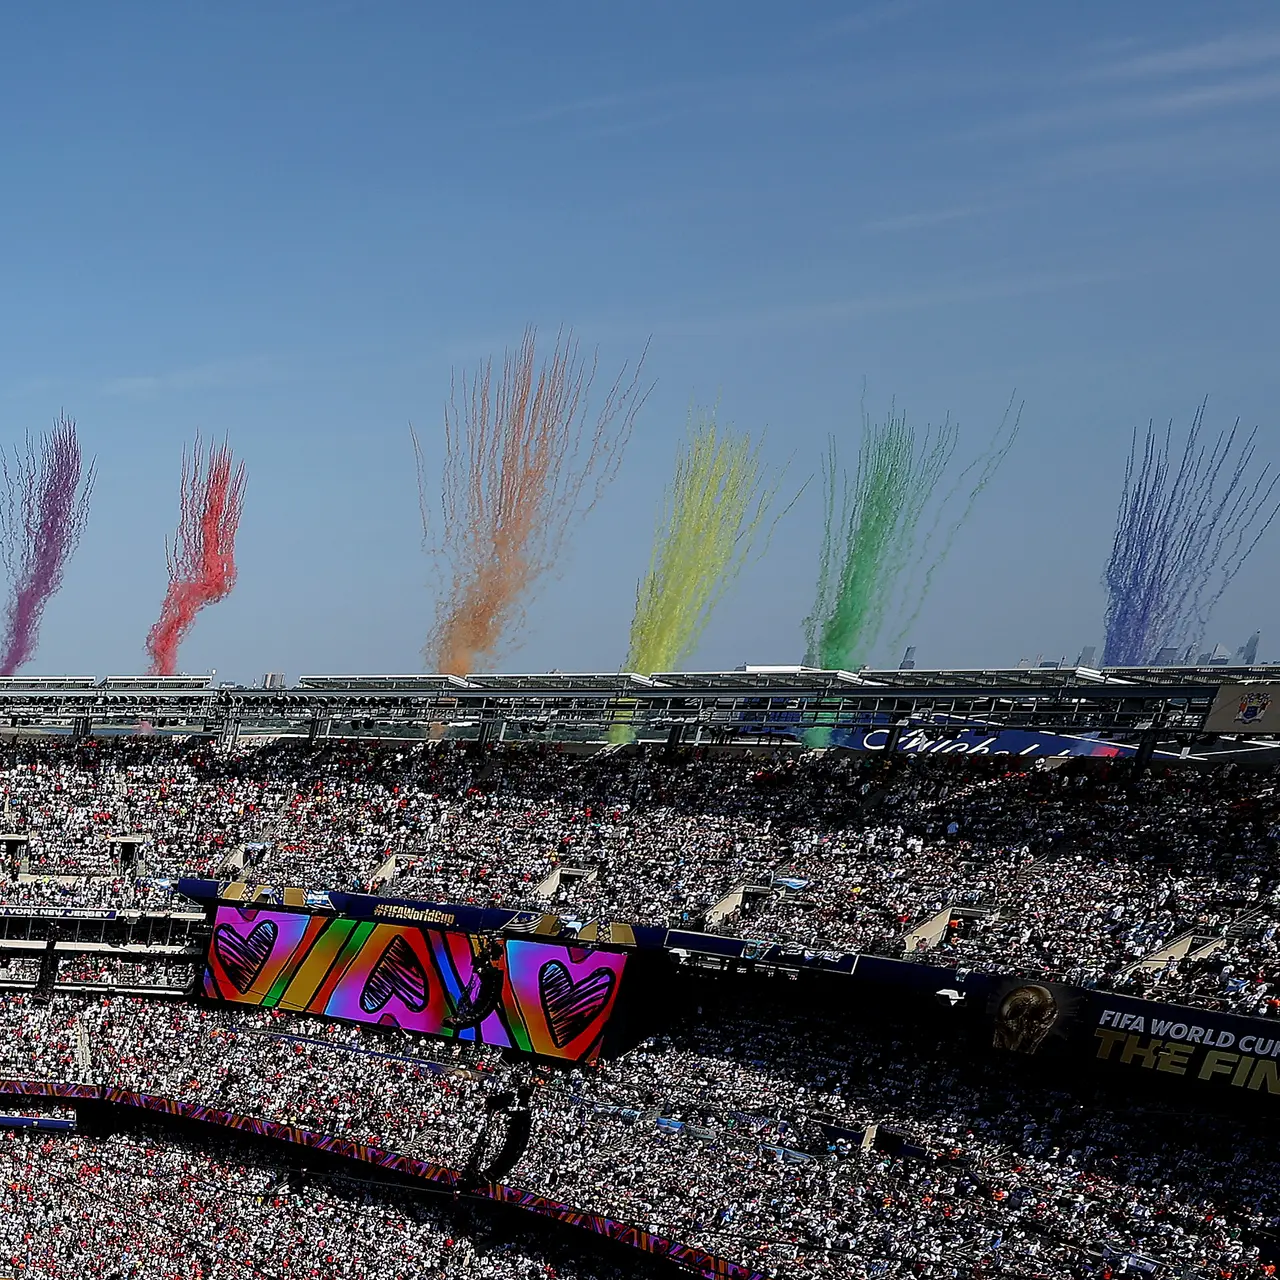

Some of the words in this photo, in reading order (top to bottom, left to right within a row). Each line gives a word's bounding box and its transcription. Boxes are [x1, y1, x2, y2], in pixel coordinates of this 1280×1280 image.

[66, 910, 110, 918] JERSEY
[374, 904, 455, 925] #FIFAWorldCup
[1099, 1010, 1145, 1032] FIFA
[1150, 1019, 1235, 1047] WORLD
[1094, 1027, 1195, 1075] THE
